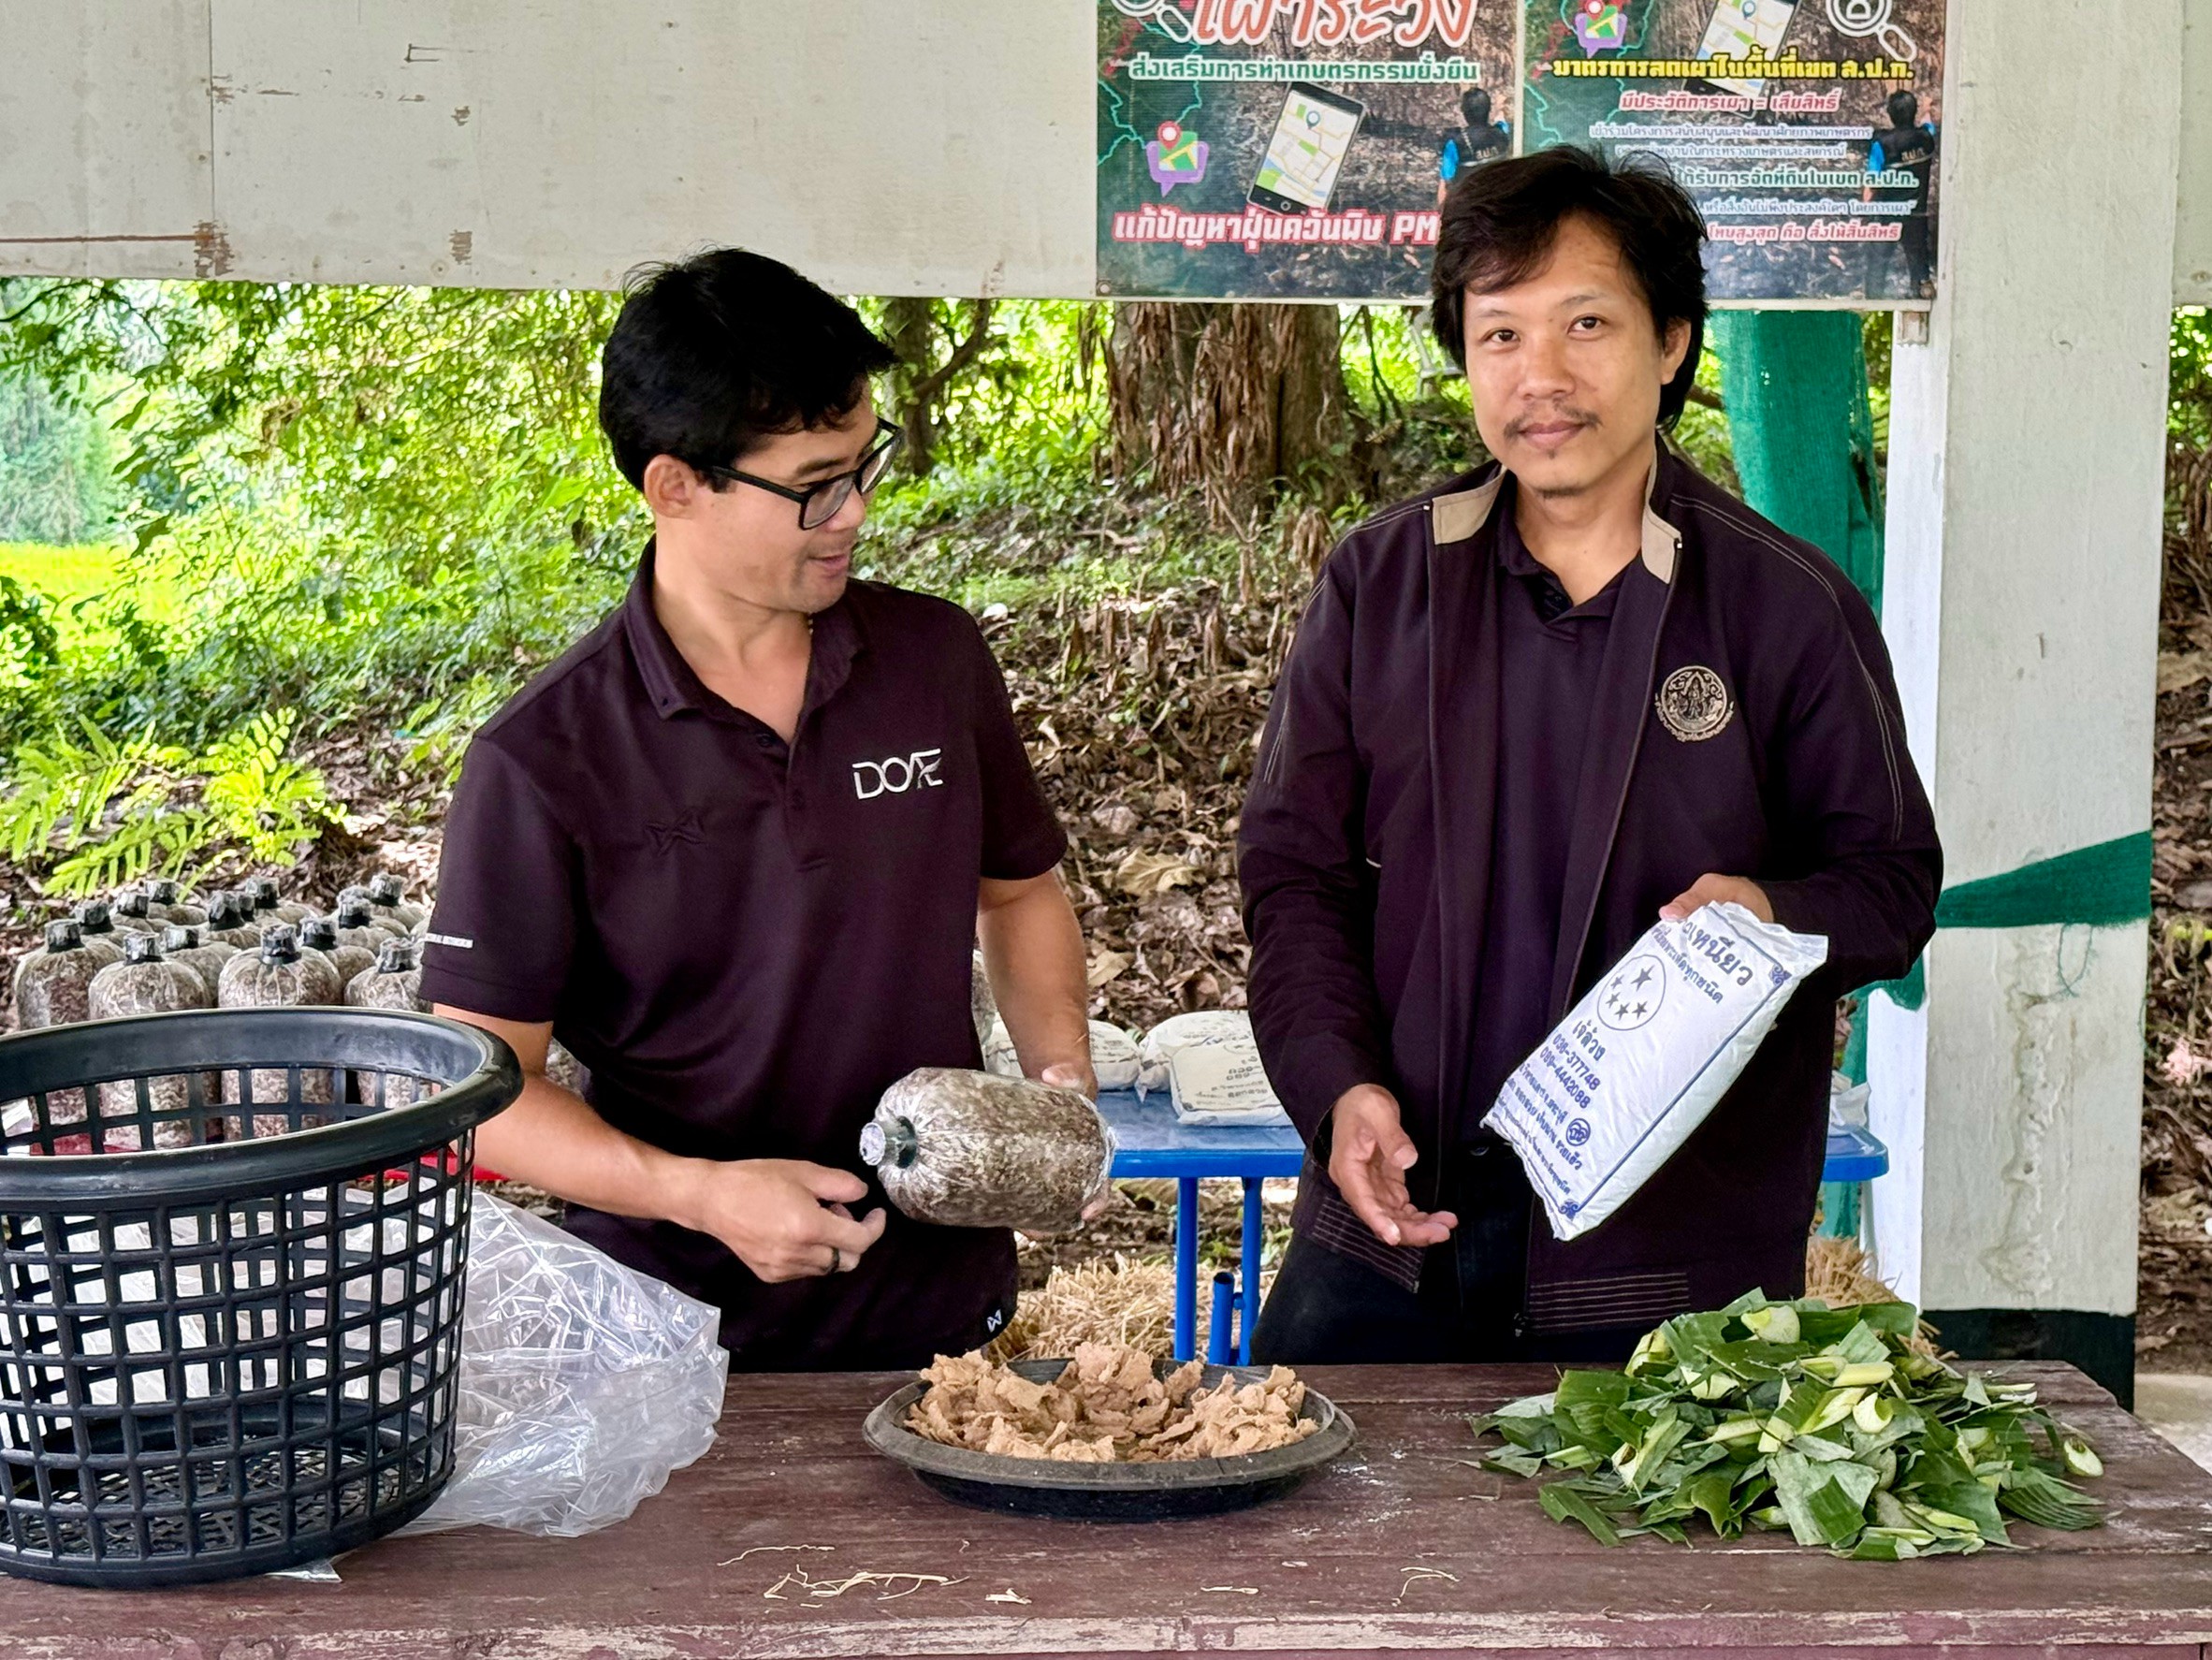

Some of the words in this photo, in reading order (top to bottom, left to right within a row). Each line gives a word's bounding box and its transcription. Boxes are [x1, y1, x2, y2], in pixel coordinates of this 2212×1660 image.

[1130, 53, 1478, 80] ส่งเสริมการทำเกษตรกรรมยั่งยืน
[1115, 206, 1383, 251] แก้ปัญหาฝุ่นควันพิษ
